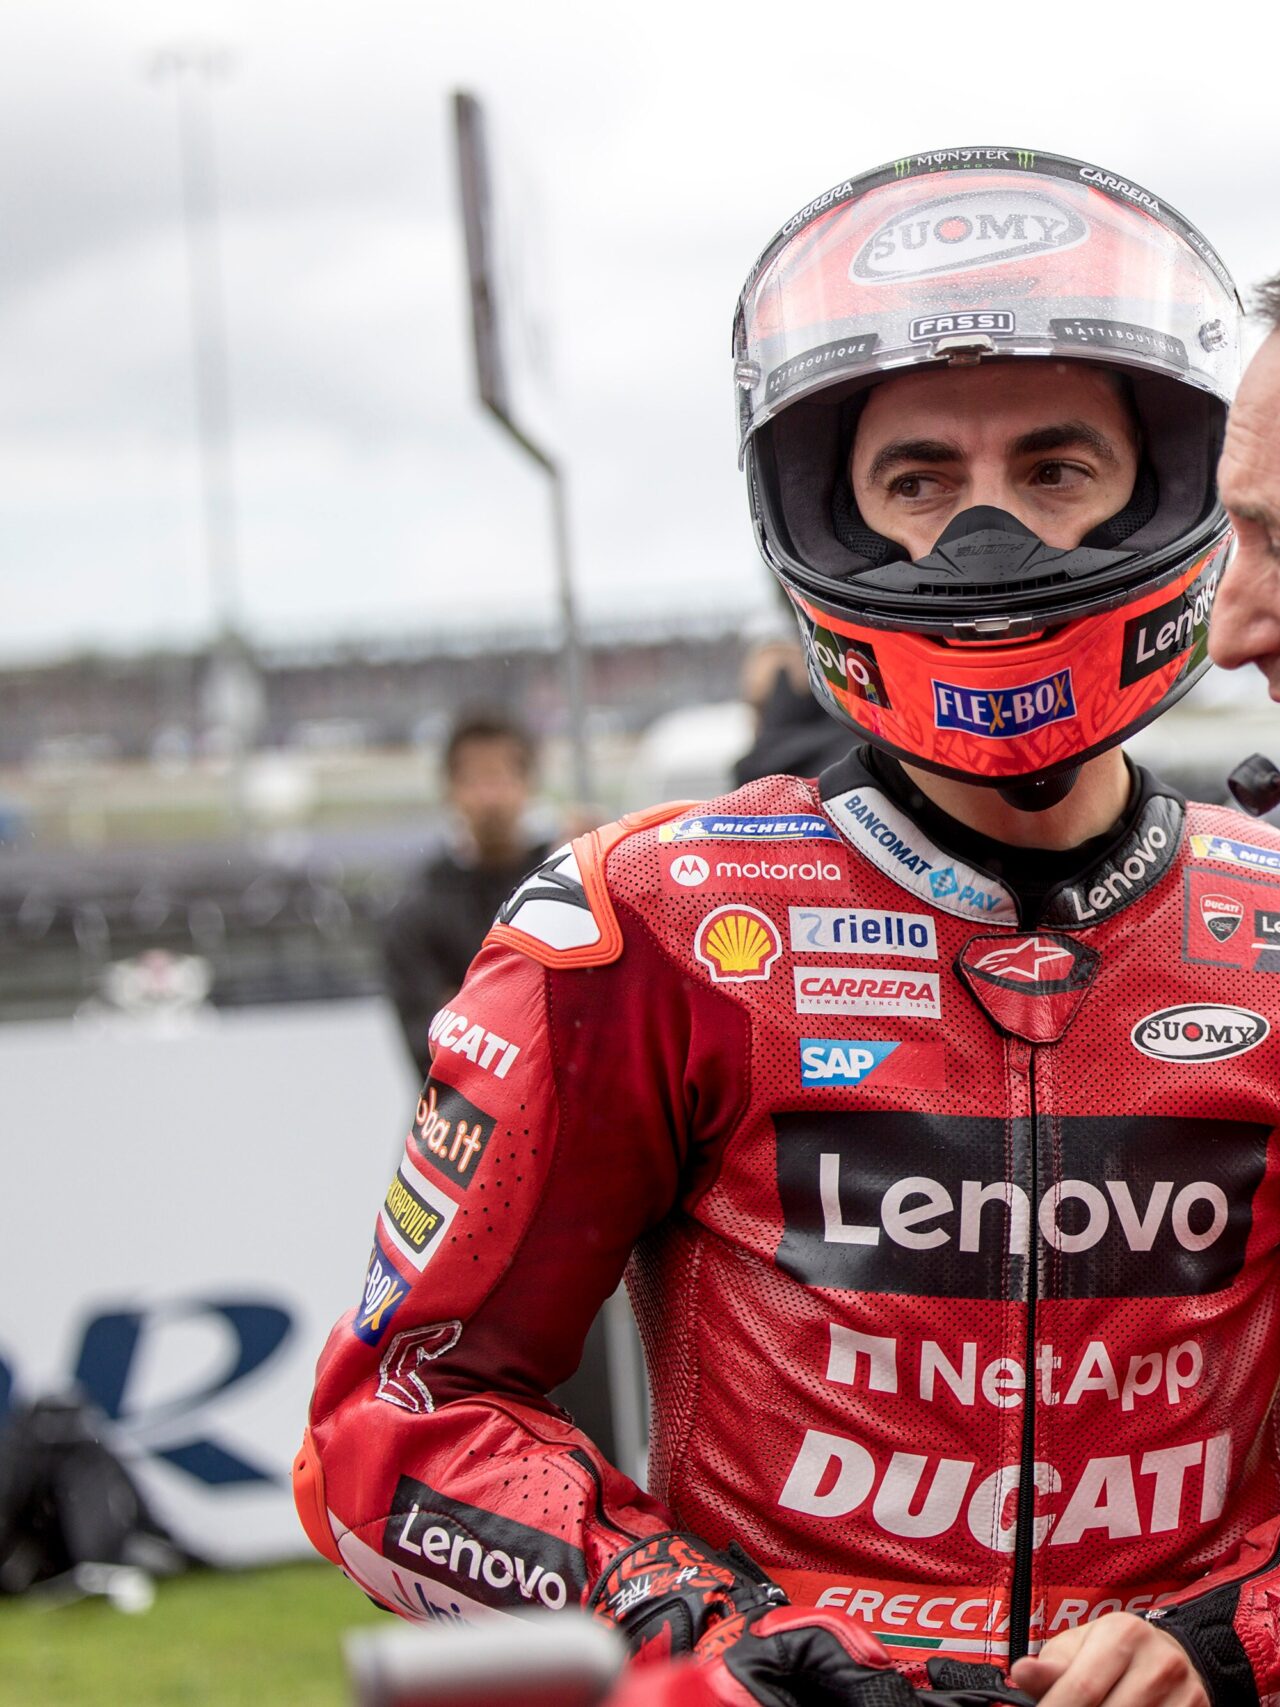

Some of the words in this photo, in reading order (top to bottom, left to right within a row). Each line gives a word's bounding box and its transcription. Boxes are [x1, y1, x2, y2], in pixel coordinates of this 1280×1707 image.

[917, 150, 1010, 166] MONSTER
[929, 163, 993, 172] ENERGY
[782, 181, 853, 235] CARRERA
[1079, 167, 1160, 213] CARRERA
[874, 214, 1066, 260] SUOMY
[919, 315, 1005, 335] FASSI
[1136, 569, 1217, 664] Lenovo
[937, 674, 1068, 734] FLEX-BOX
[711, 821, 827, 834] MICHELIN
[716, 860, 841, 881] motorola
[844, 795, 933, 876] BANCOMAT
[958, 886, 1001, 911] PAY
[1071, 825, 1168, 921] Lenovo
[1204, 899, 1240, 914] DUCATI
[832, 914, 928, 948] riello
[800, 977, 935, 1002] CARRERA
[1147, 1020, 1254, 1044] SUOMY
[802, 1046, 875, 1079] SAP
[416, 1086, 482, 1173] uba.it
[819, 1153, 1229, 1255] Lenovo
[919, 1337, 1204, 1411] NetApp
[777, 1429, 1232, 1553] DUCATI
[398, 1503, 567, 1611] Lenovo
